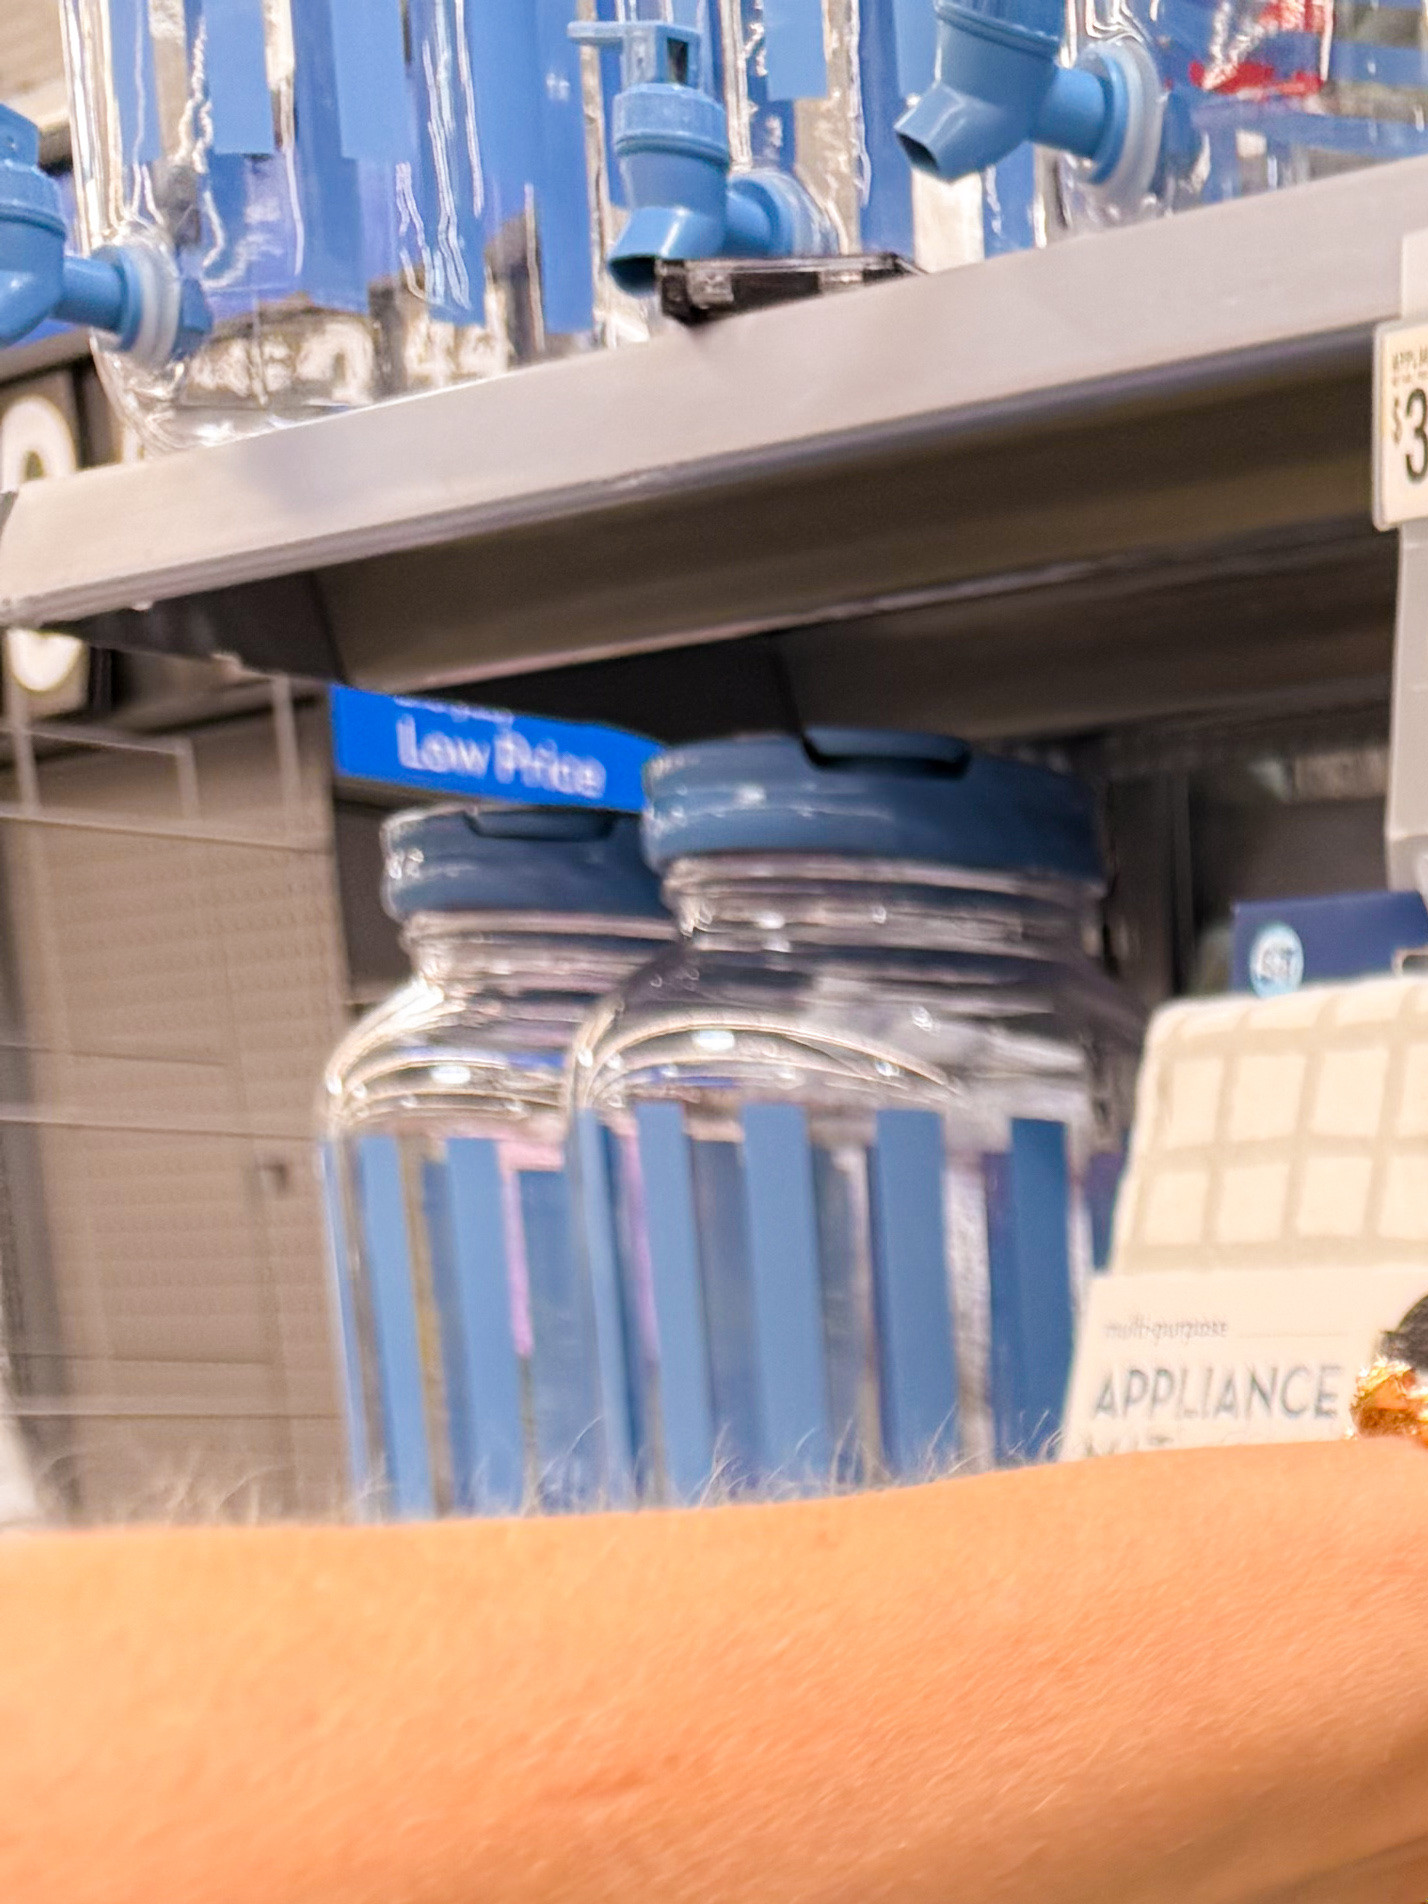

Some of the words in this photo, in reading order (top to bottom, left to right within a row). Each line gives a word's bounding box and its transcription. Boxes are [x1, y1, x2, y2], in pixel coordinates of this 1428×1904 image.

[395, 712, 491, 780] Low
[493, 727, 607, 799] Price
[1093, 1364, 1343, 1421] APPLIANCE
